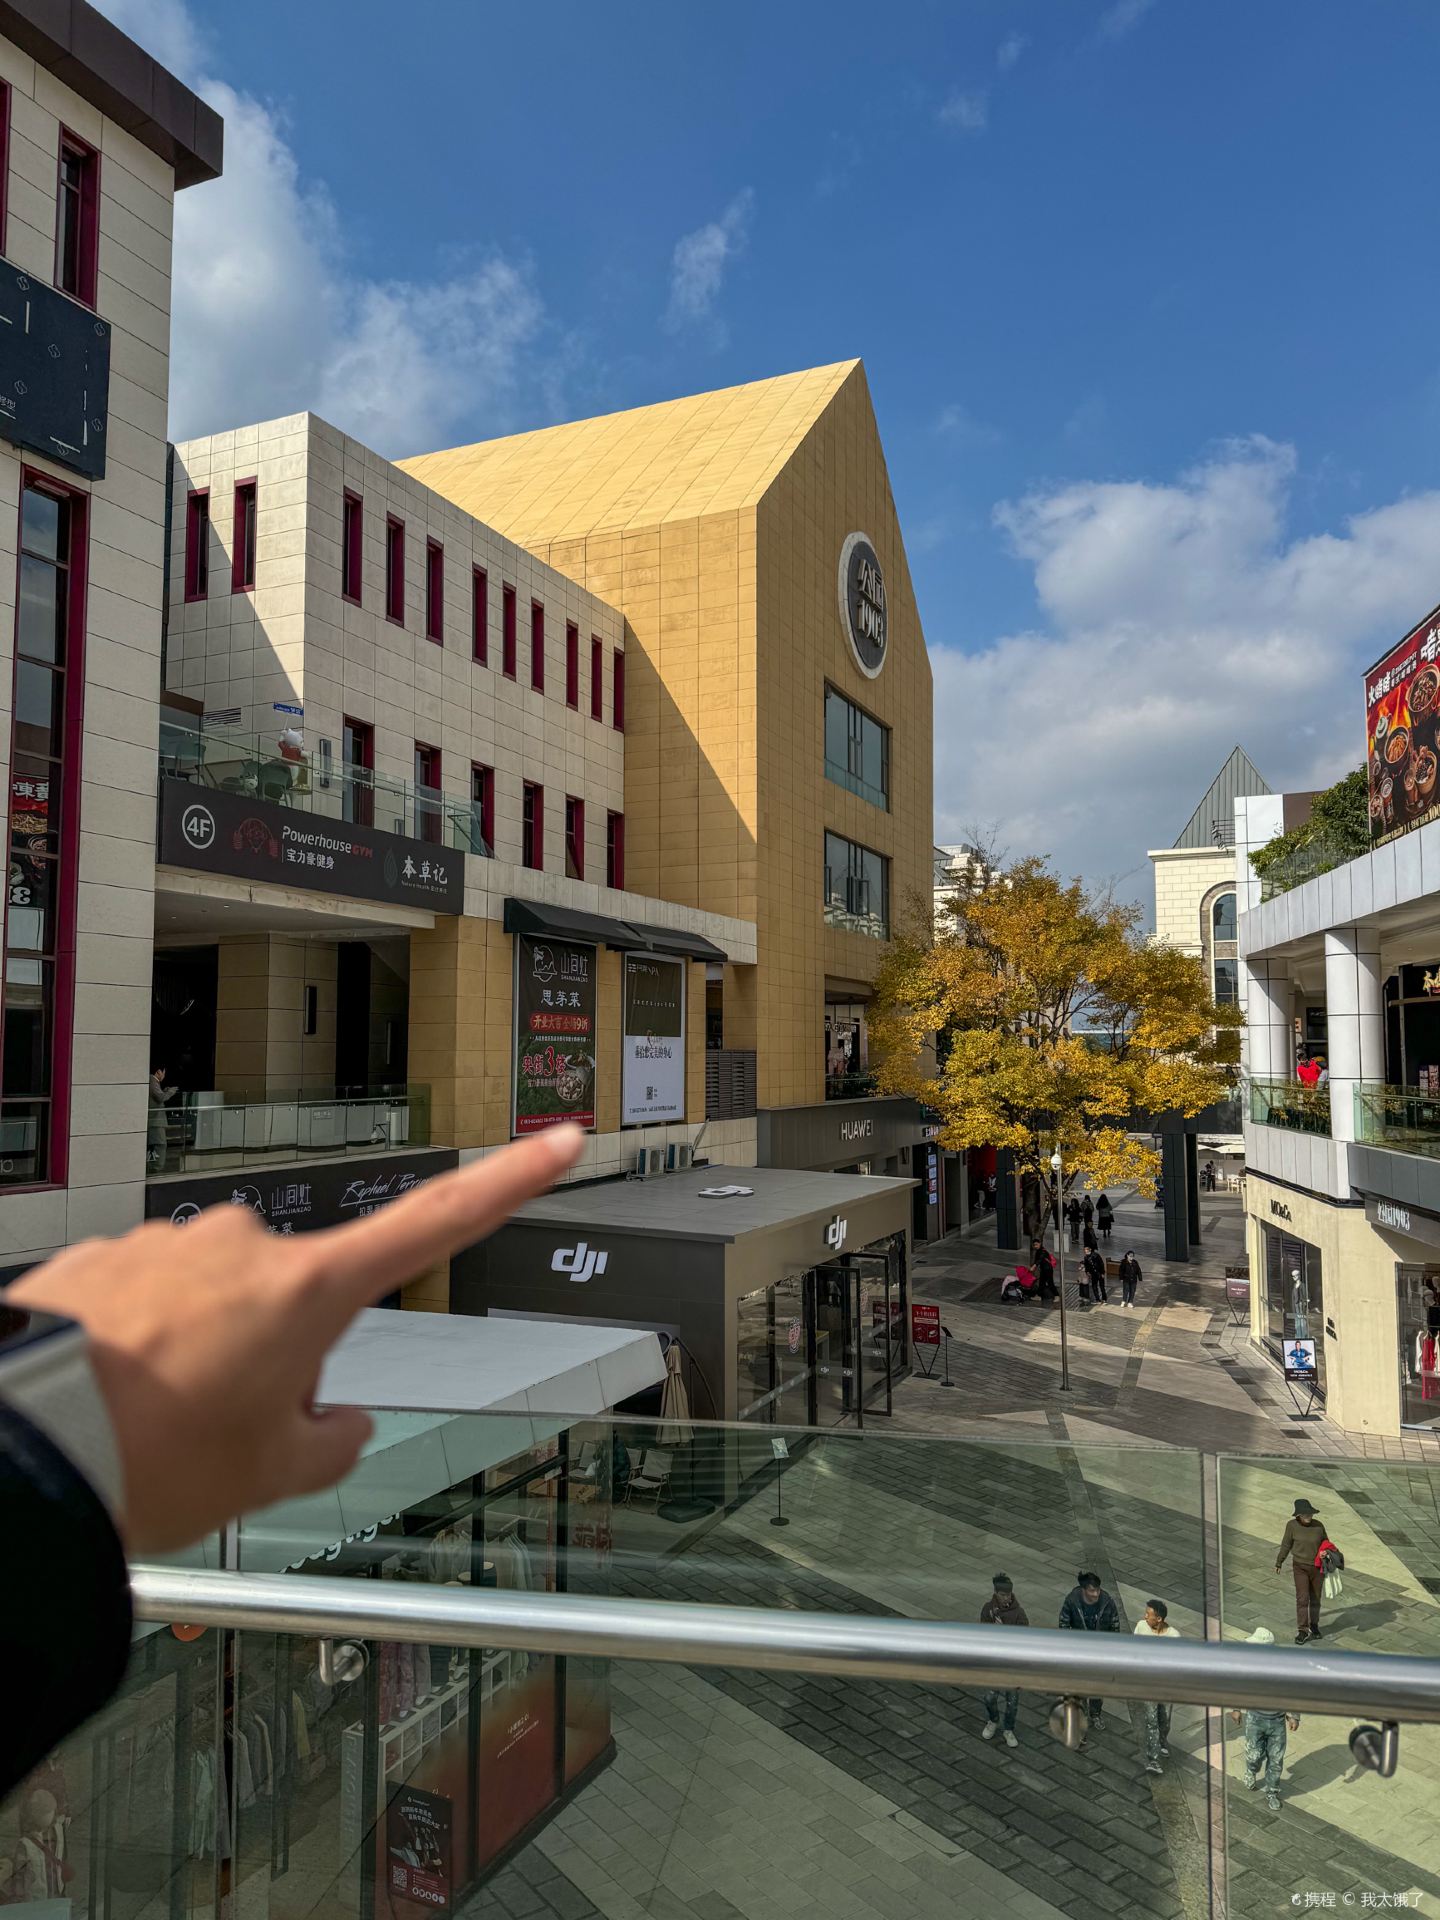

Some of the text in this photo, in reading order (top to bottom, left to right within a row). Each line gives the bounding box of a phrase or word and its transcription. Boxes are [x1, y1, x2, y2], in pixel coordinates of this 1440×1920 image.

[858, 598, 883, 648] 1903
[187, 816, 211, 838] 4F
[282, 826, 352, 854] Powerhouse
[286, 848, 335, 870] 宝力豪健身
[402, 855, 448, 885] 本草记
[541, 989, 581, 1008] 思茅菜
[271, 1183, 312, 1210] 山间灶
[271, 1206, 312, 1217] SHANJIANZAO
